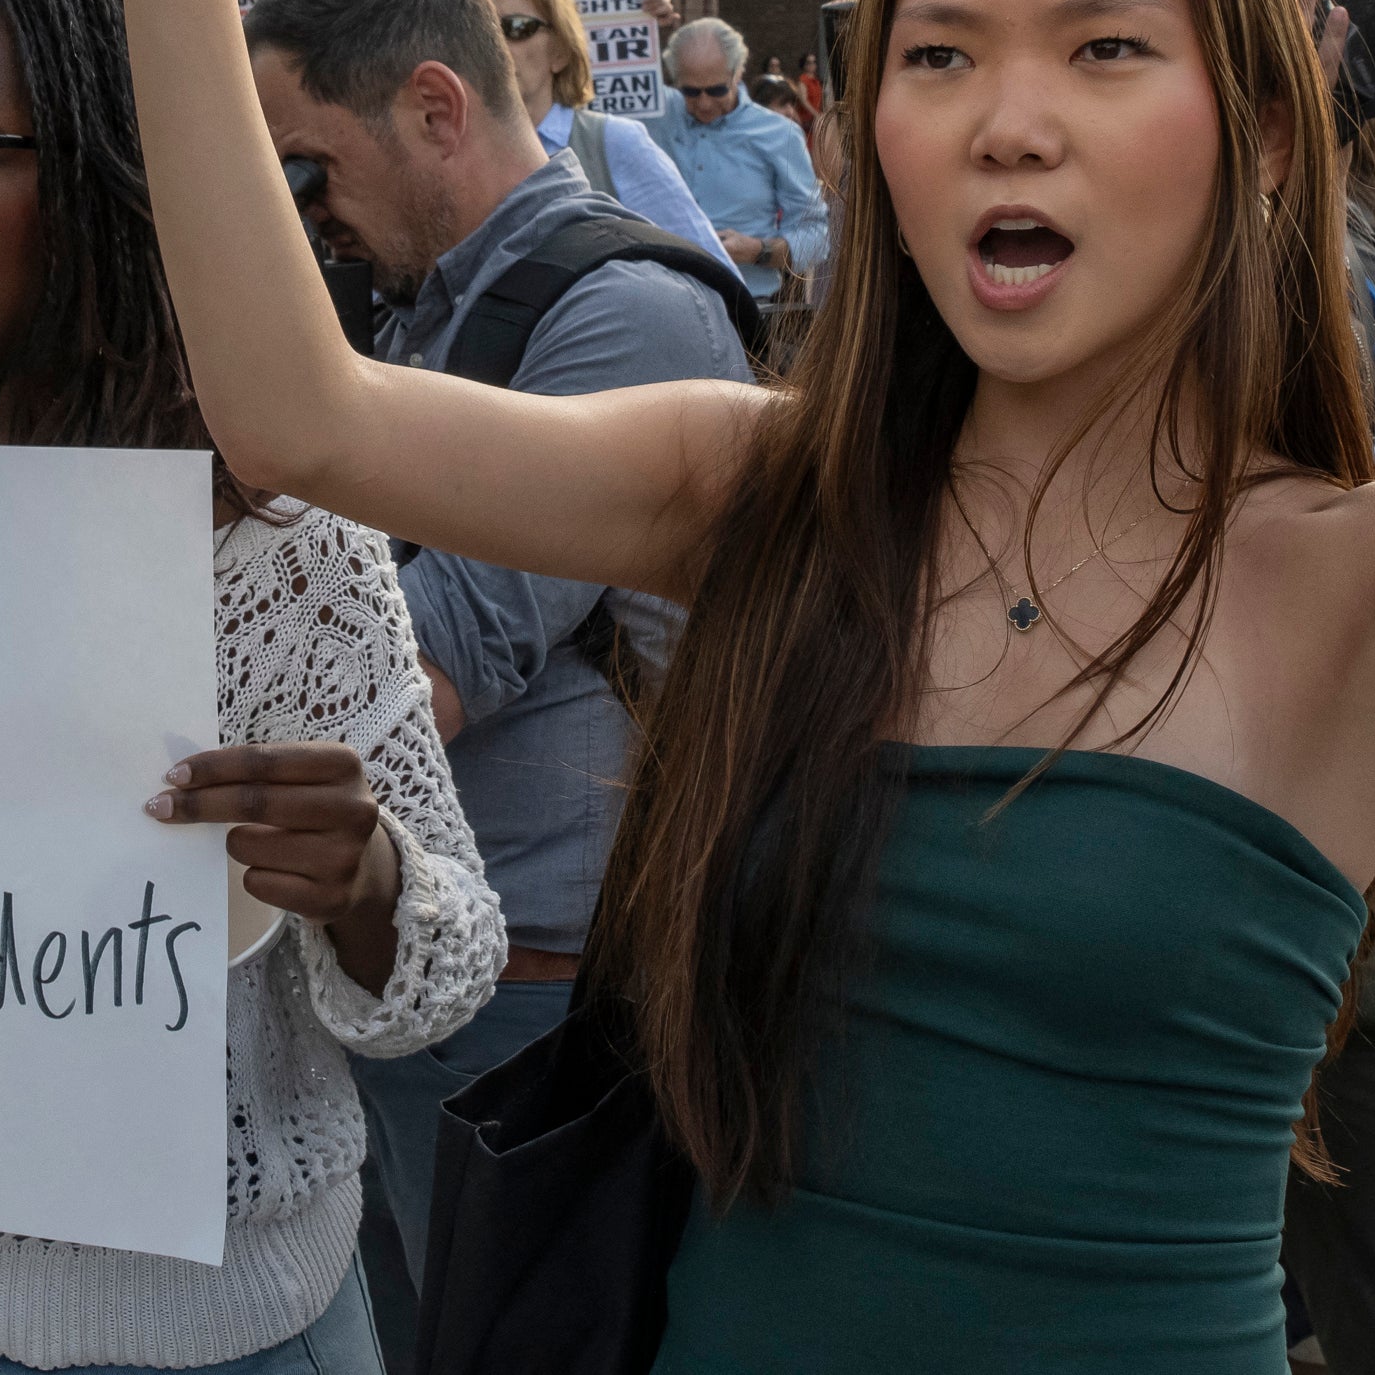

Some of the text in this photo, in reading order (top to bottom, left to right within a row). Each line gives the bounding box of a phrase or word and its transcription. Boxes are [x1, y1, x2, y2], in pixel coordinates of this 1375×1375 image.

[596, 39, 651, 62] IR
[592, 75, 651, 96] EAN
[587, 95, 652, 112] ERGY
